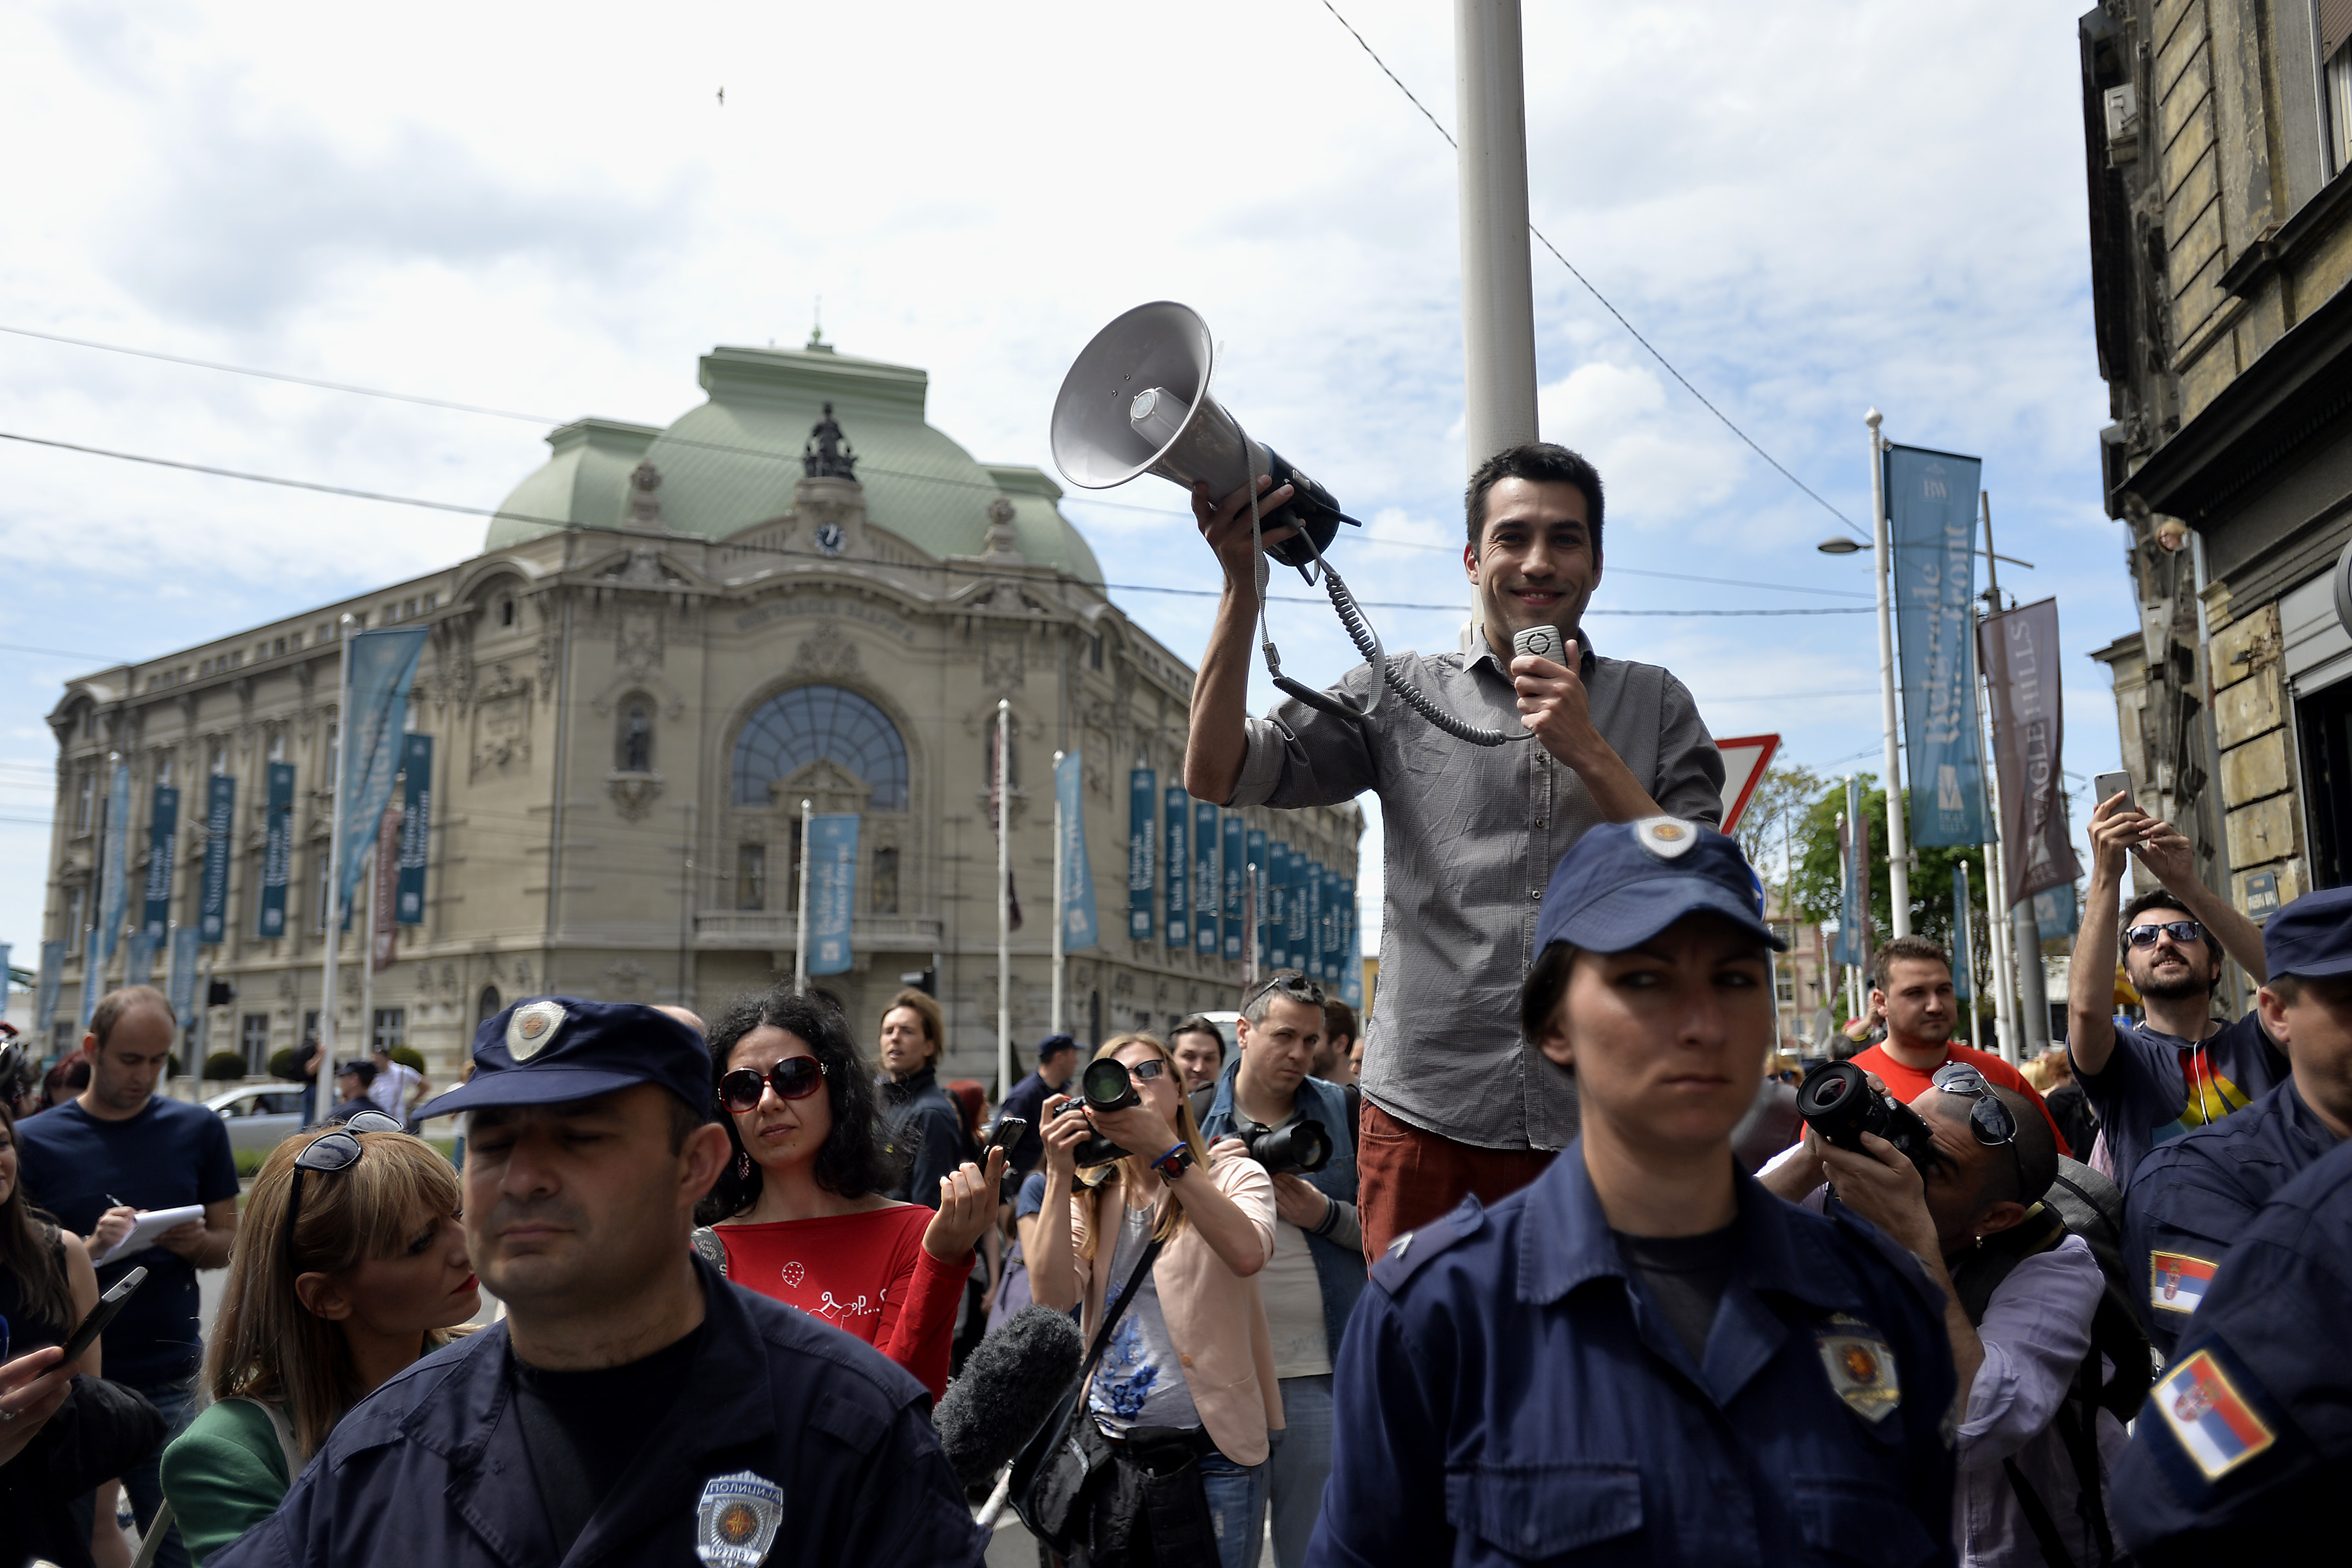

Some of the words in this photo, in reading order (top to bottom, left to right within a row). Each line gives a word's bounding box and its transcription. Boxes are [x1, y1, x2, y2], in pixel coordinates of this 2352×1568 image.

[1913, 563, 1950, 745] Belgrade
[2012, 620, 2040, 715] HILLS
[2026, 721, 2050, 826] EAGLE
[710, 1482, 780, 1501] ПОЛИЦИЈА
[711, 1546, 752, 1560] 127067
